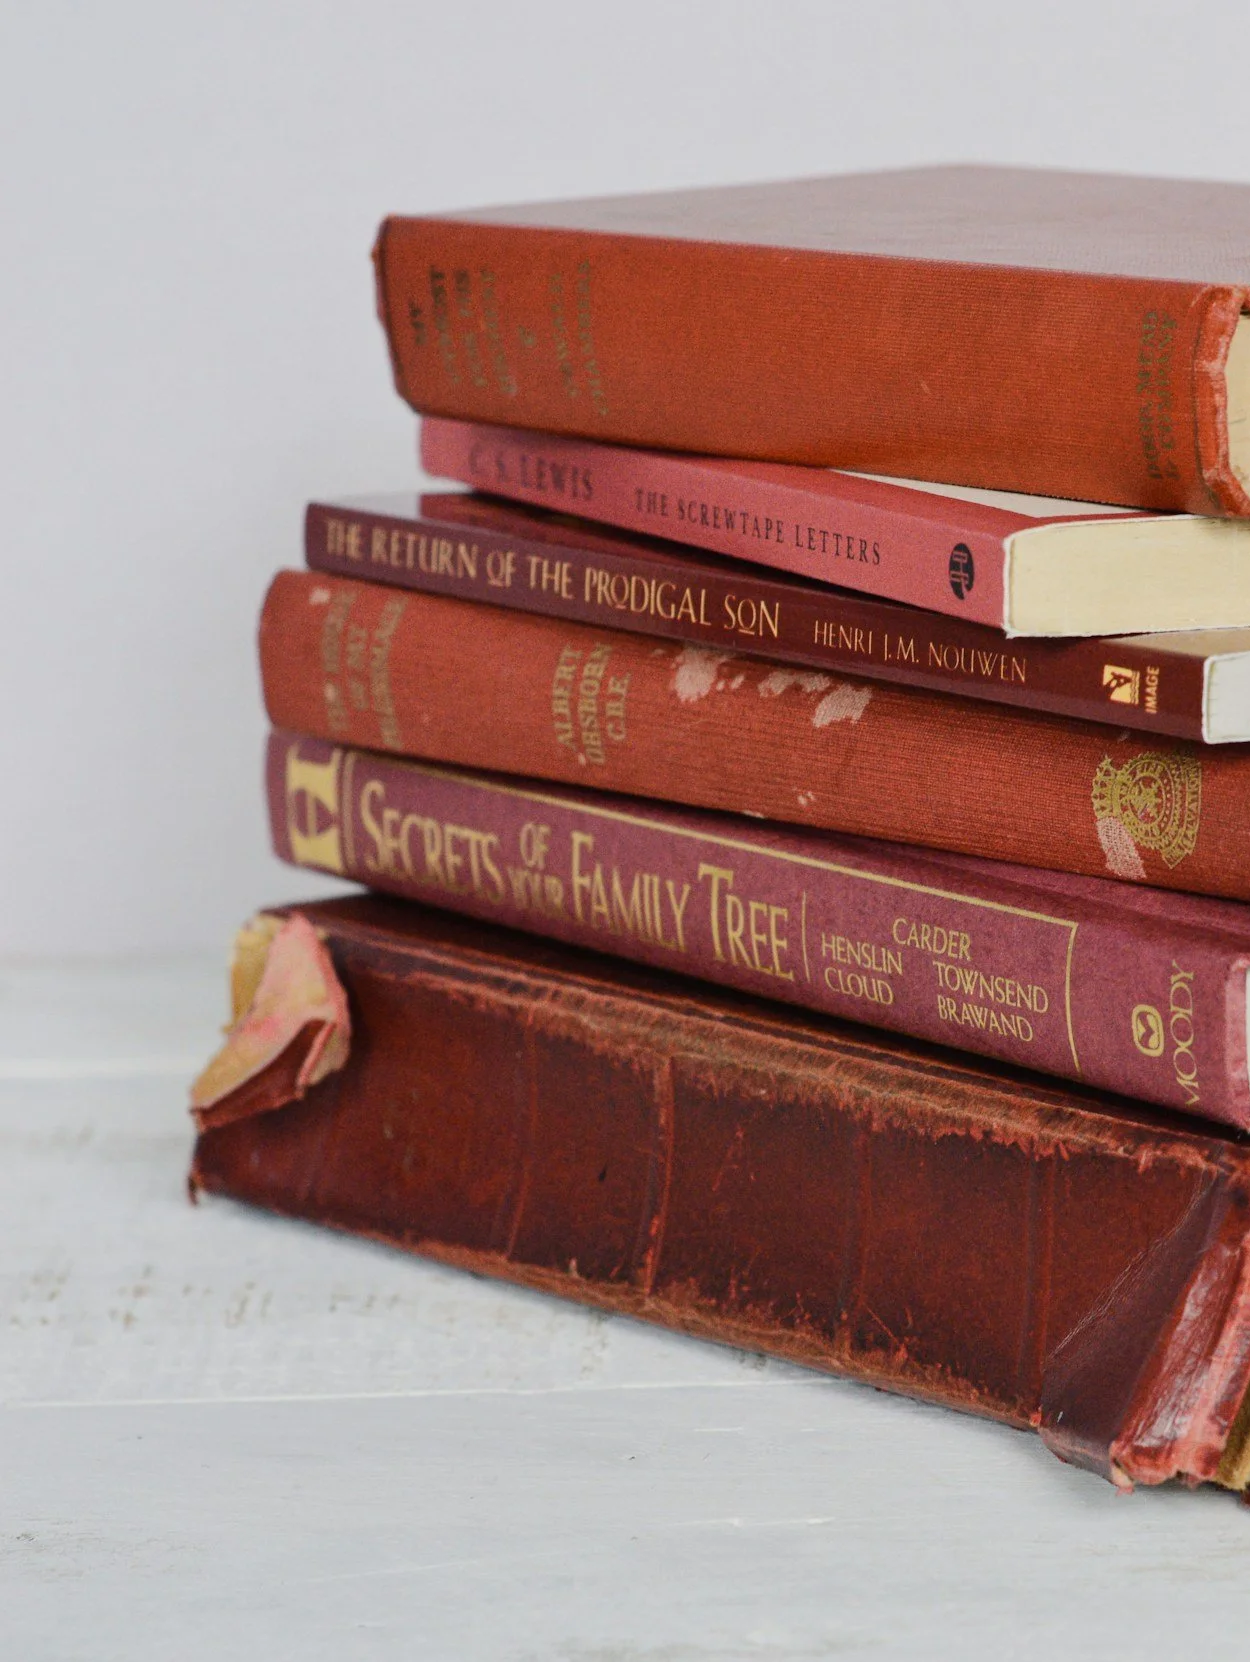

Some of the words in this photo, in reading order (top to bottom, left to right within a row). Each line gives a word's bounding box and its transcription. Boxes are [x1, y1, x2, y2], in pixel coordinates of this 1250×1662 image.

[519, 452, 596, 501] LEWIS
[634, 486, 670, 518] THE
[676, 495, 788, 545] SCREWTAPE
[795, 525, 882, 567] LETTERS
[326, 518, 363, 560] THE
[371, 527, 480, 580] RETURN
[486, 548, 518, 589] OF
[527, 555, 573, 600] THE
[584, 566, 712, 628] PRODIGAL
[724, 592, 781, 640] SON
[813, 619, 874, 655] HENRI
[927, 640, 1029, 684] NOUWEN
[1144, 665, 1160, 714] IMAGE
[359, 781, 502, 905] SECRETS
[519, 822, 552, 868] OF
[508, 866, 565, 914] YOUR
[571, 831, 692, 953] FAMILY
[699, 863, 795, 984] TREE
[892, 918, 972, 962] CARDER
[821, 932, 903, 975] HENSLIN
[824, 967, 894, 1006] CLOUD
[932, 960, 1049, 1014] TOWNSEND
[936, 994, 1034, 1043] BRAWAND
[1169, 959, 1198, 1107] MOODY
